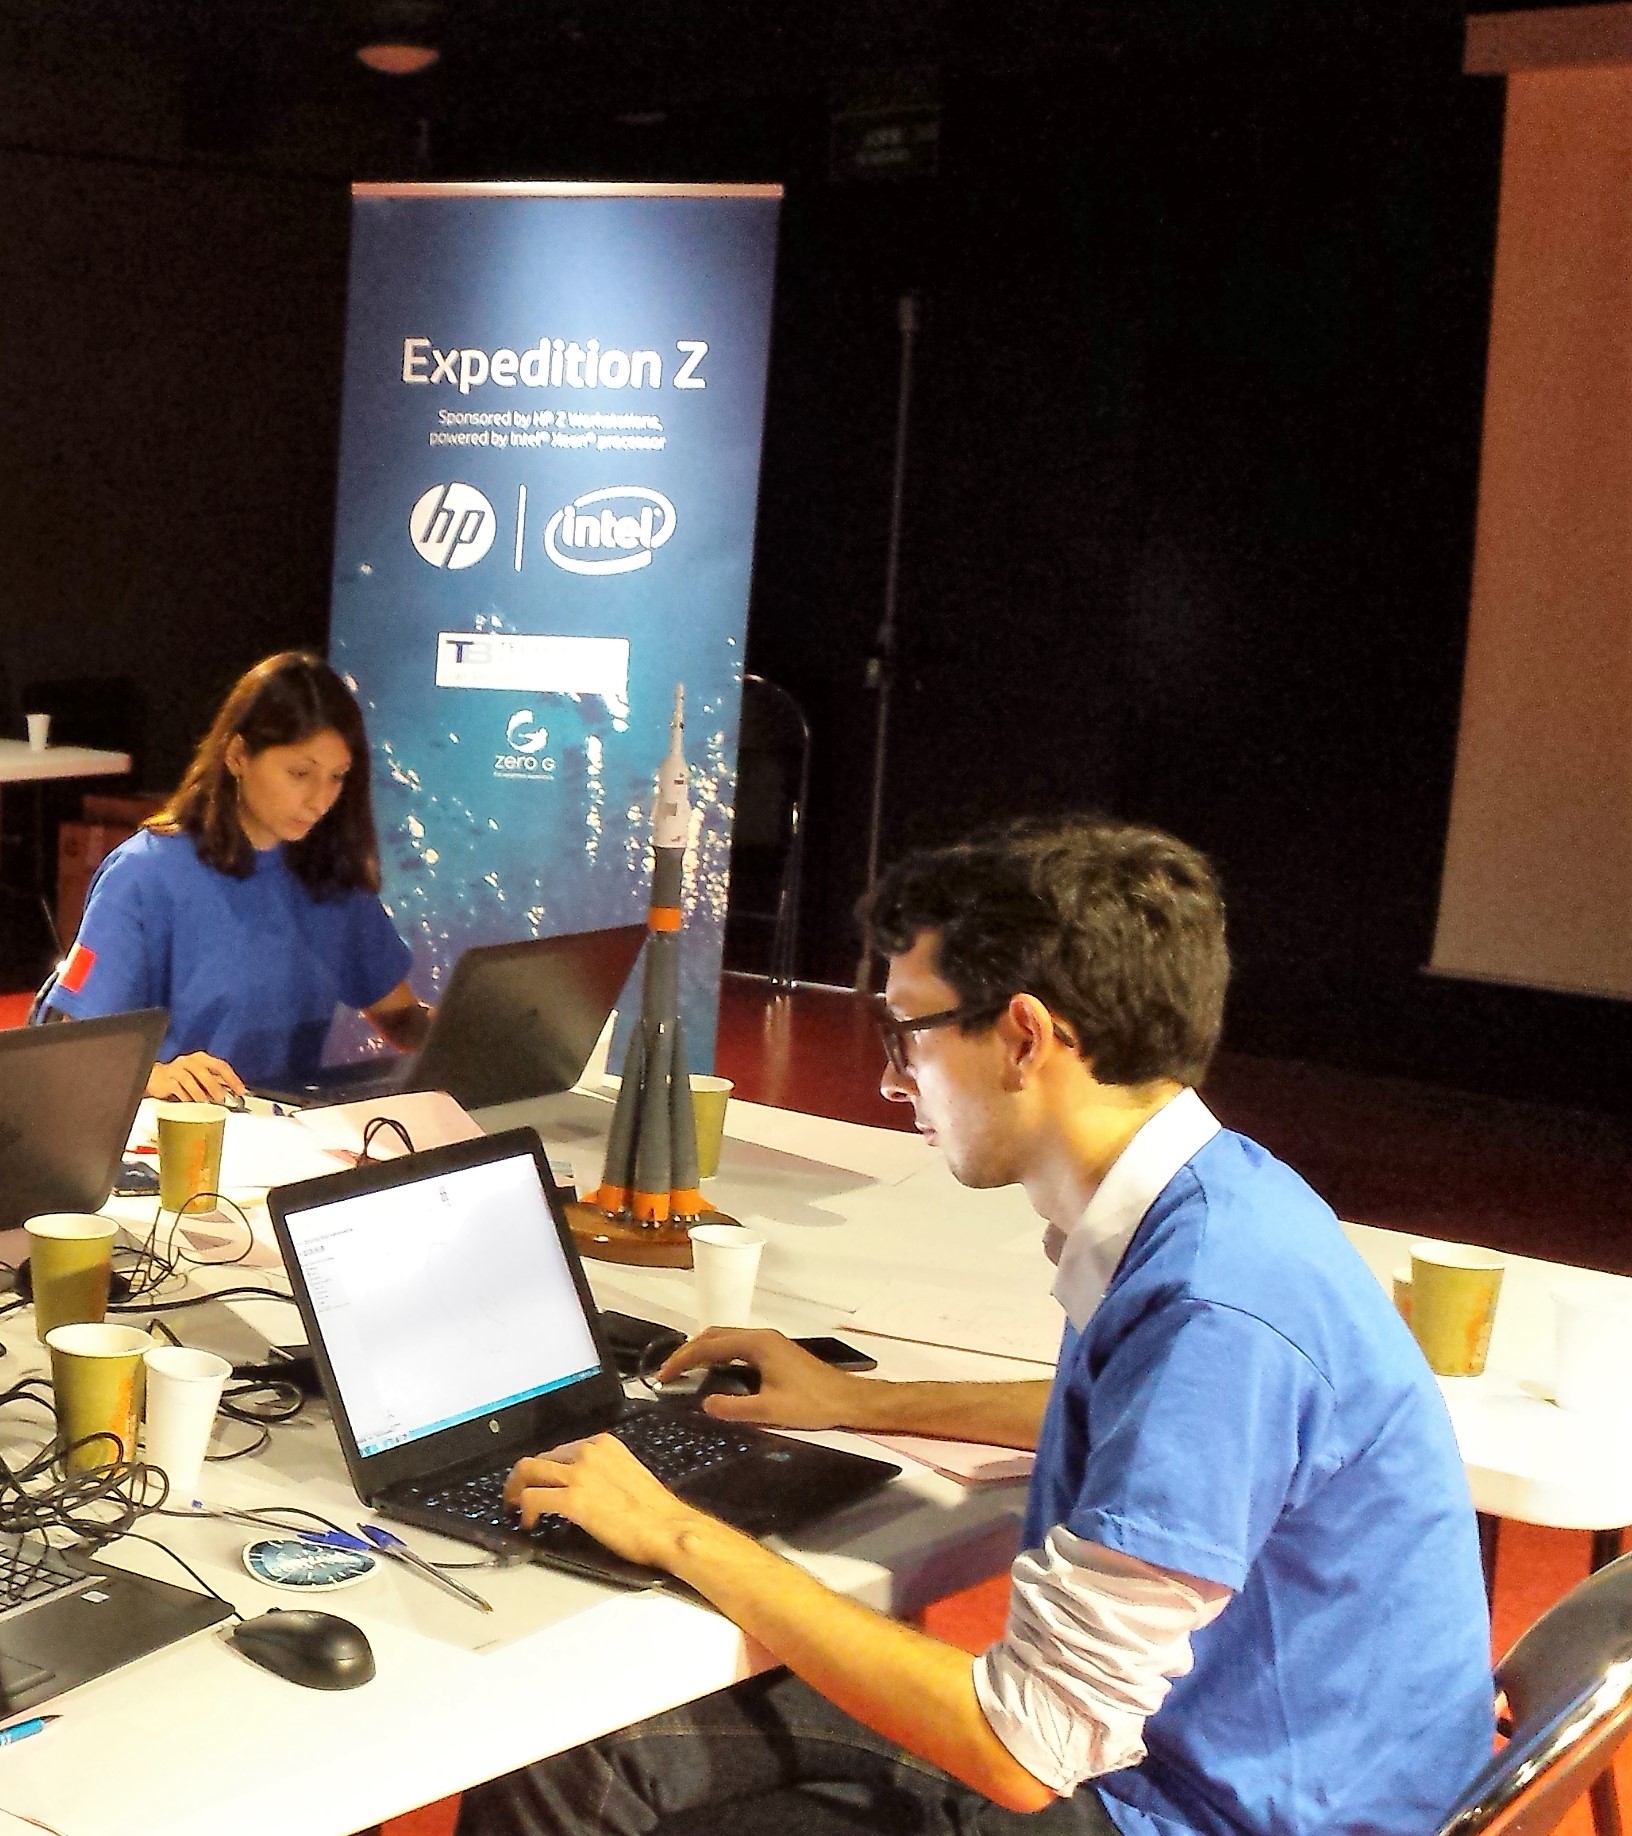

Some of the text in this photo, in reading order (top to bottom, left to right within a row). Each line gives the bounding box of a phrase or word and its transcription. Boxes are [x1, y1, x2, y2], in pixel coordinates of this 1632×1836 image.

[402, 336, 709, 395] Expedition Z
[437, 408, 511, 427] Sponsored
[513, 410, 531, 430] by
[532, 409, 554, 427] HP
[429, 430, 489, 446] powered
[490, 431, 509, 449] by
[415, 483, 488, 569] hp
[494, 753, 557, 772] zero G
